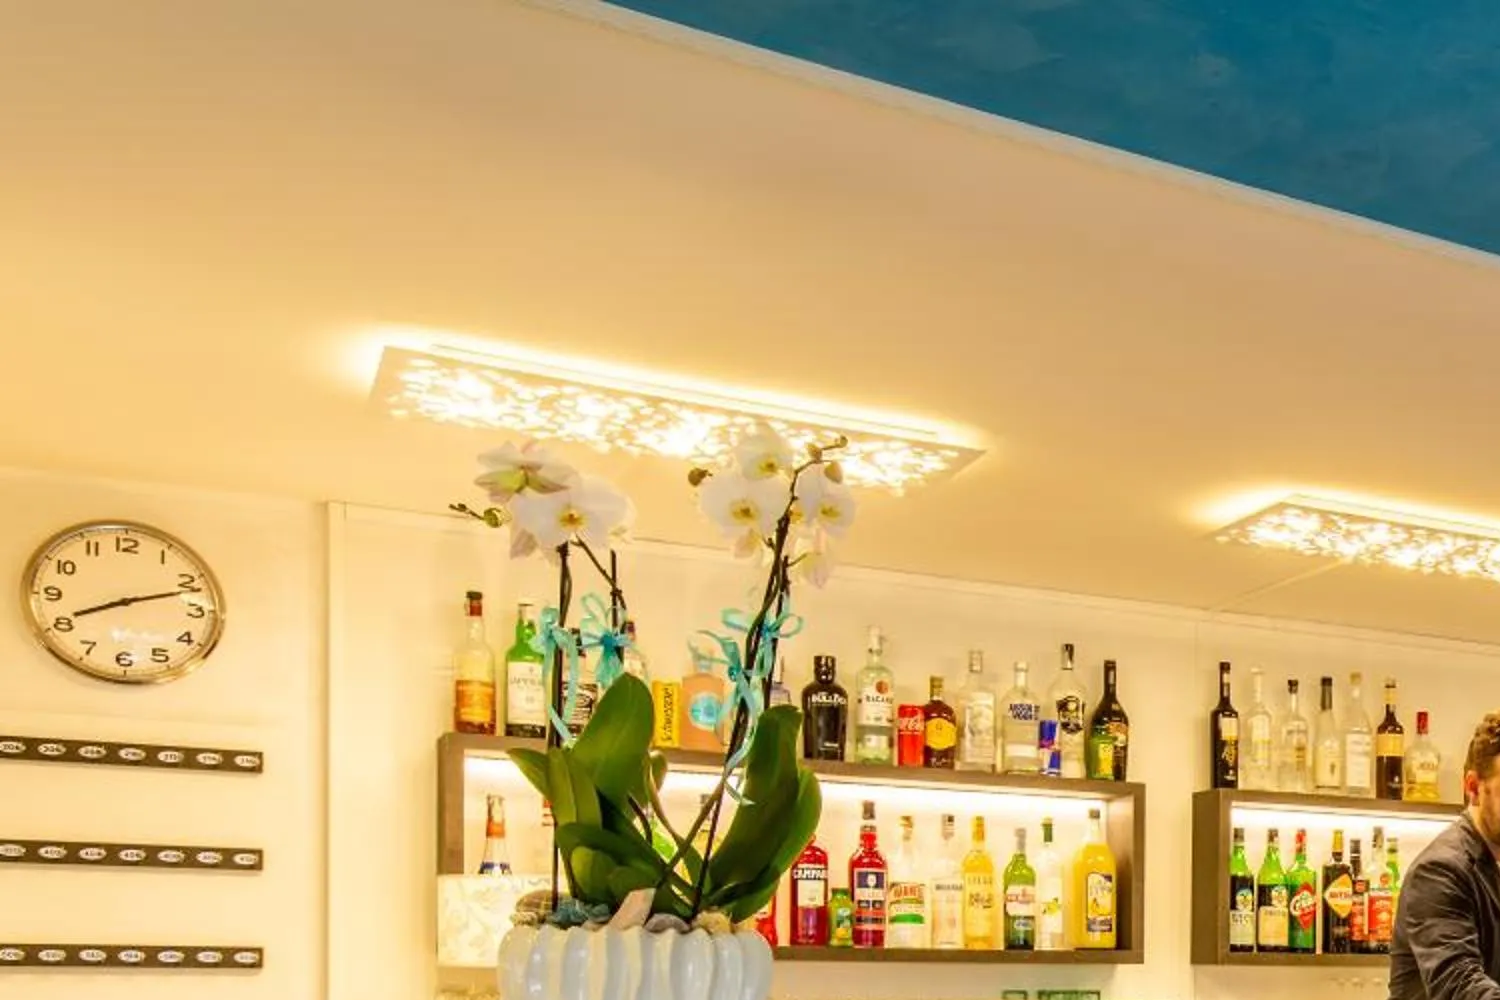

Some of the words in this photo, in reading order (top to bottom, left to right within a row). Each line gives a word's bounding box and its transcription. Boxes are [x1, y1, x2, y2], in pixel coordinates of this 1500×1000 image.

[85, 540, 99, 557] 11
[115, 536, 140, 554] 12
[160, 549, 166, 565] 1
[56, 559, 77, 575] 10
[177, 573, 202, 592] 2
[43, 585, 63, 601] 9
[187, 603, 206, 618] 3
[53, 616, 74, 632] 8
[175, 631, 195, 646] 4
[79, 640, 97, 656] 7
[150, 647, 170, 663] 5
[115, 651, 134, 667] 6
